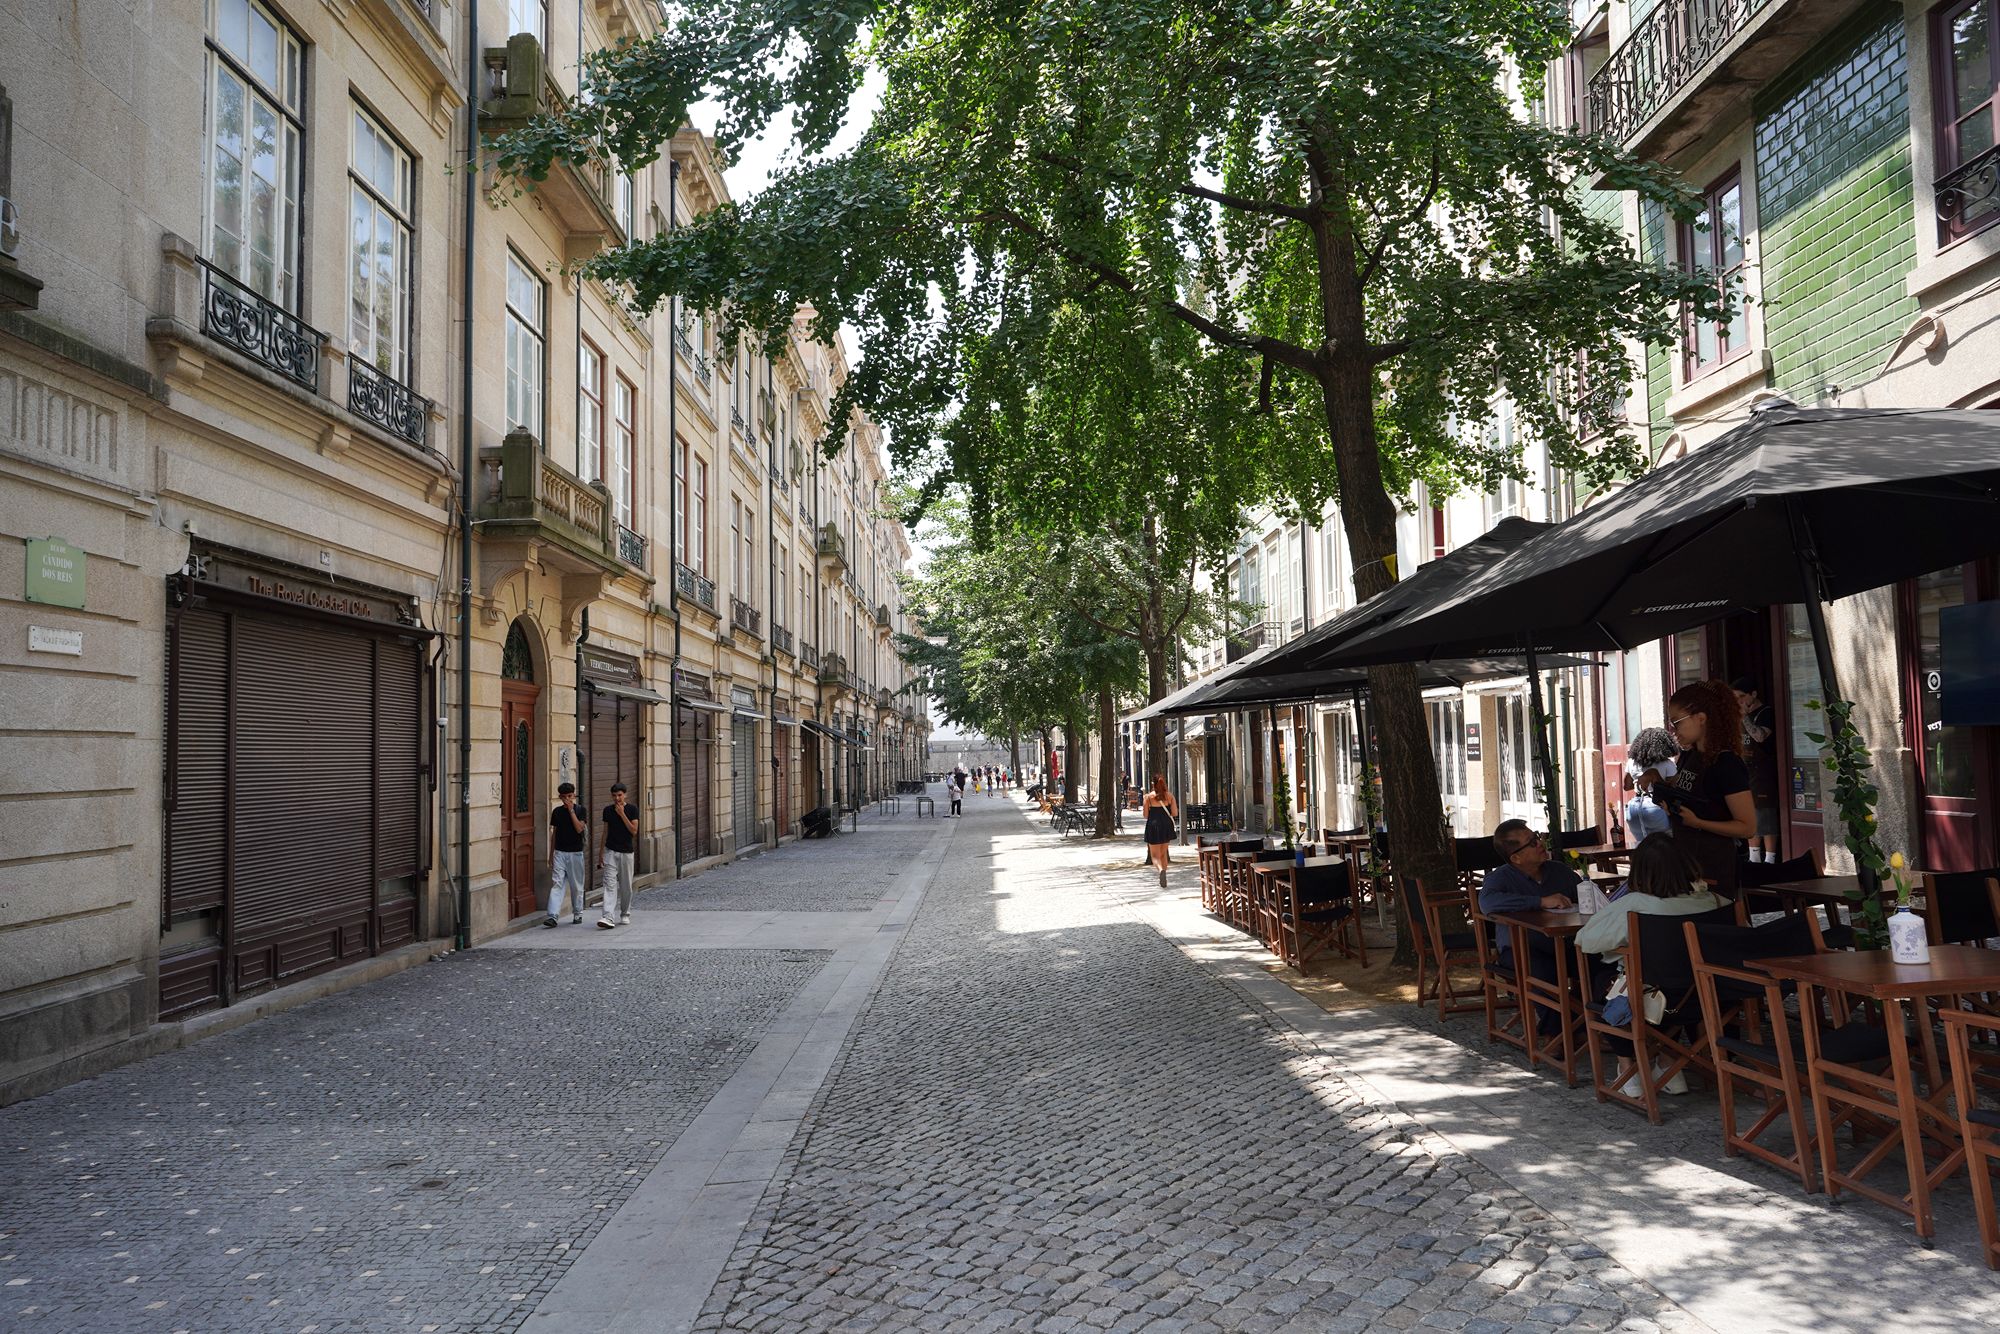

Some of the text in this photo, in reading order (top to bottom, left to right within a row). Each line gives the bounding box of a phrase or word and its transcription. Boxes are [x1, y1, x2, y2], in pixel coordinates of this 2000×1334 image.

[42, 553, 73, 570] CÂNDIDO
[42, 567, 73, 583] DOS REIS
[249, 576, 373, 618] The Royal Cocktail Club
[1644, 599, 1729, 613] ESTRELLA DAMM
[1927, 720, 1942, 731] very
